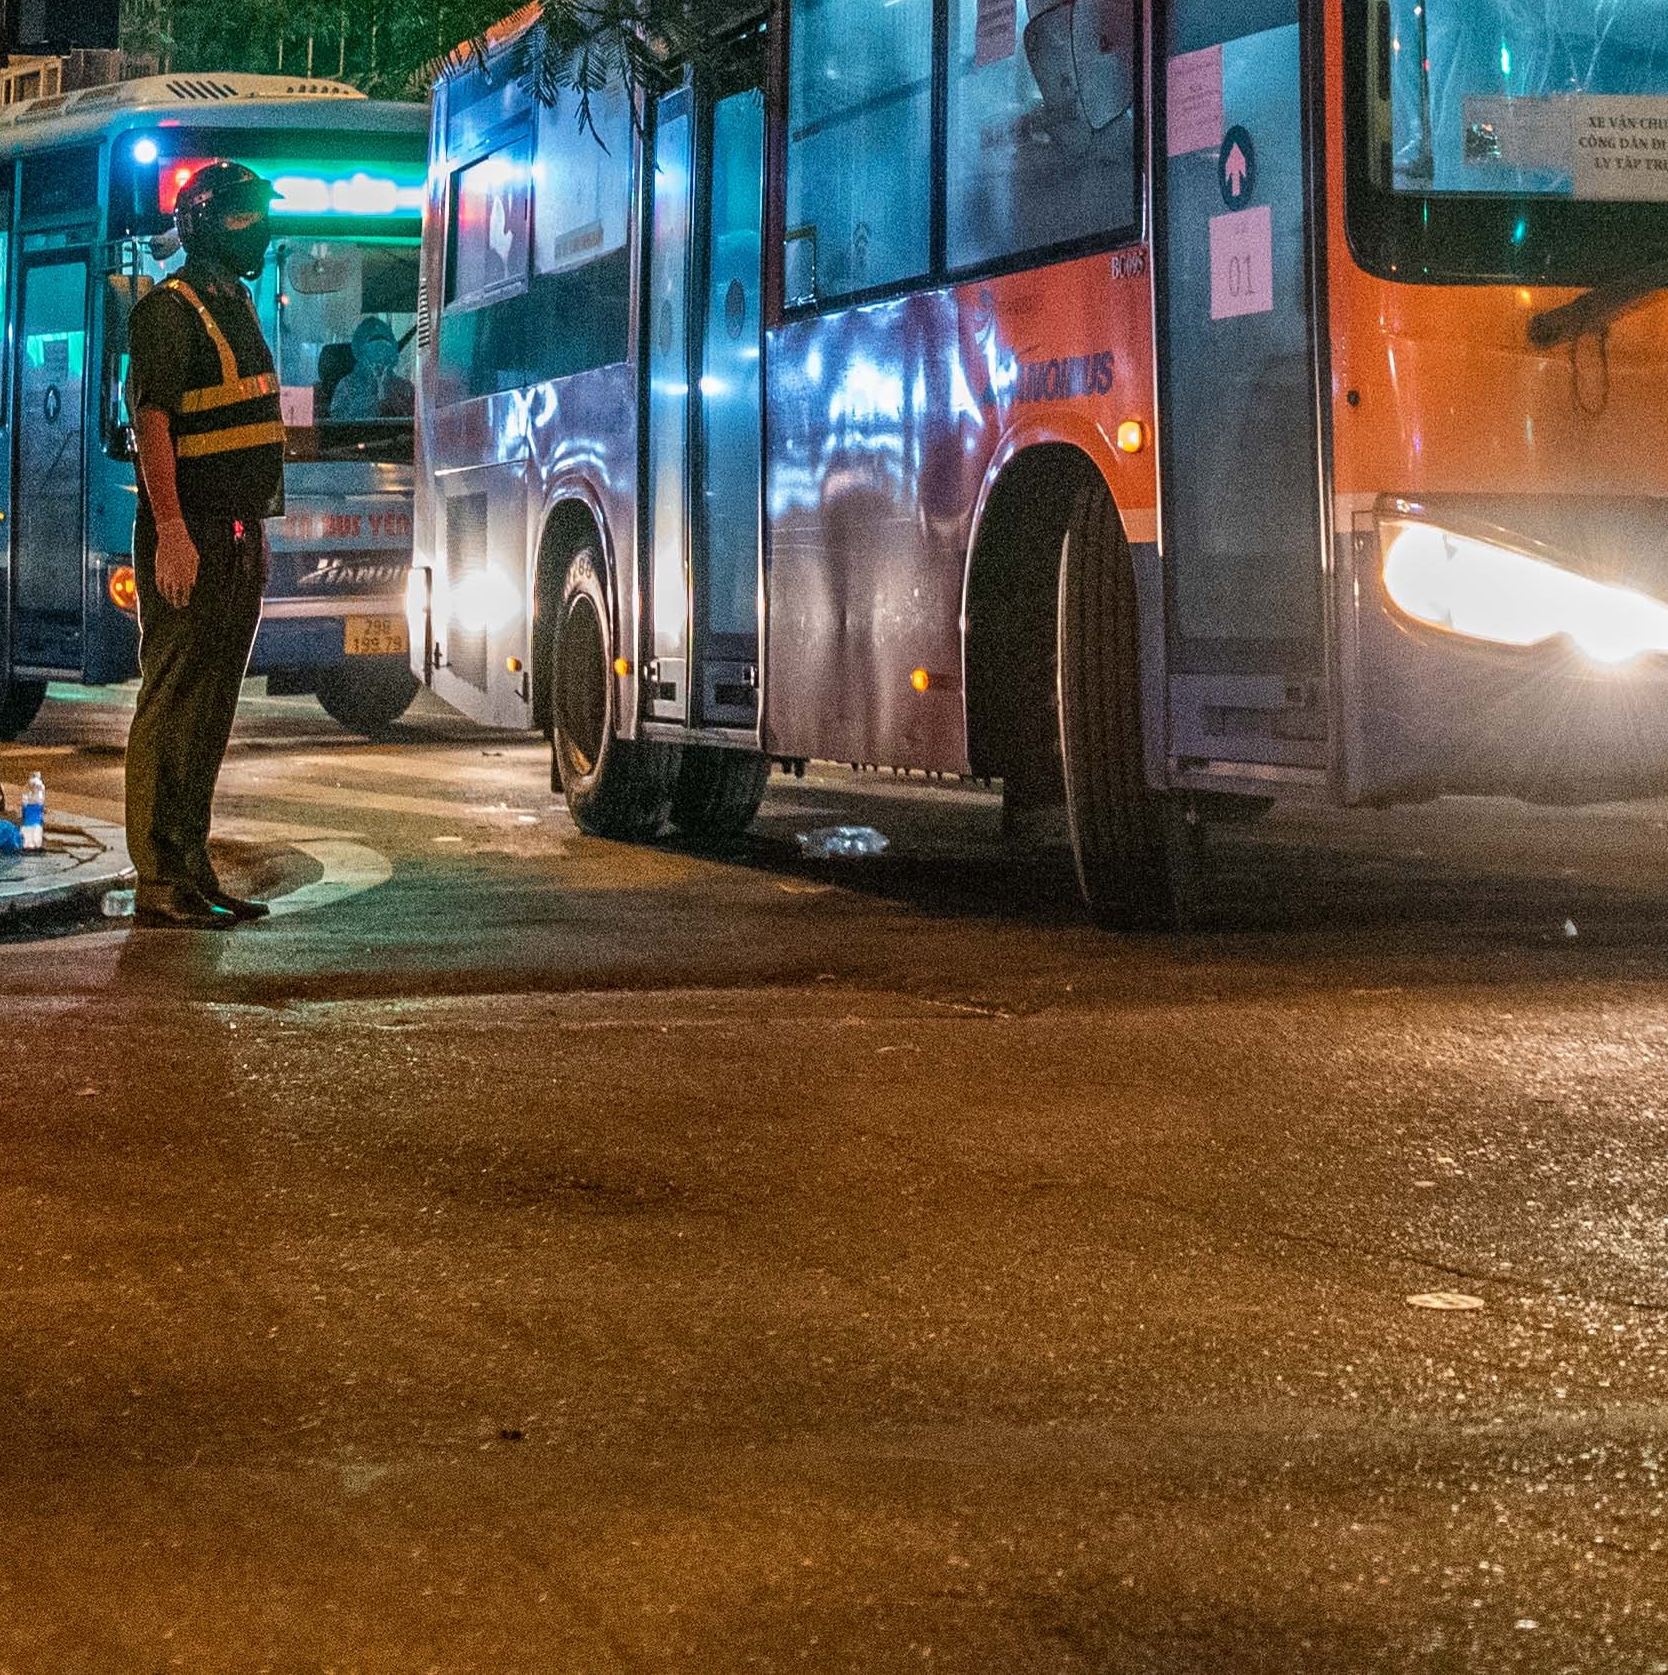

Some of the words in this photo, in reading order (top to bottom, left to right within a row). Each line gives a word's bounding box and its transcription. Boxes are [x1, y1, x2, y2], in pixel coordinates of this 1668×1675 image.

[1588, 116, 1605, 129] XE
[1578, 134, 1616, 149] CÔNG
[1228, 254, 1255, 298] 01
